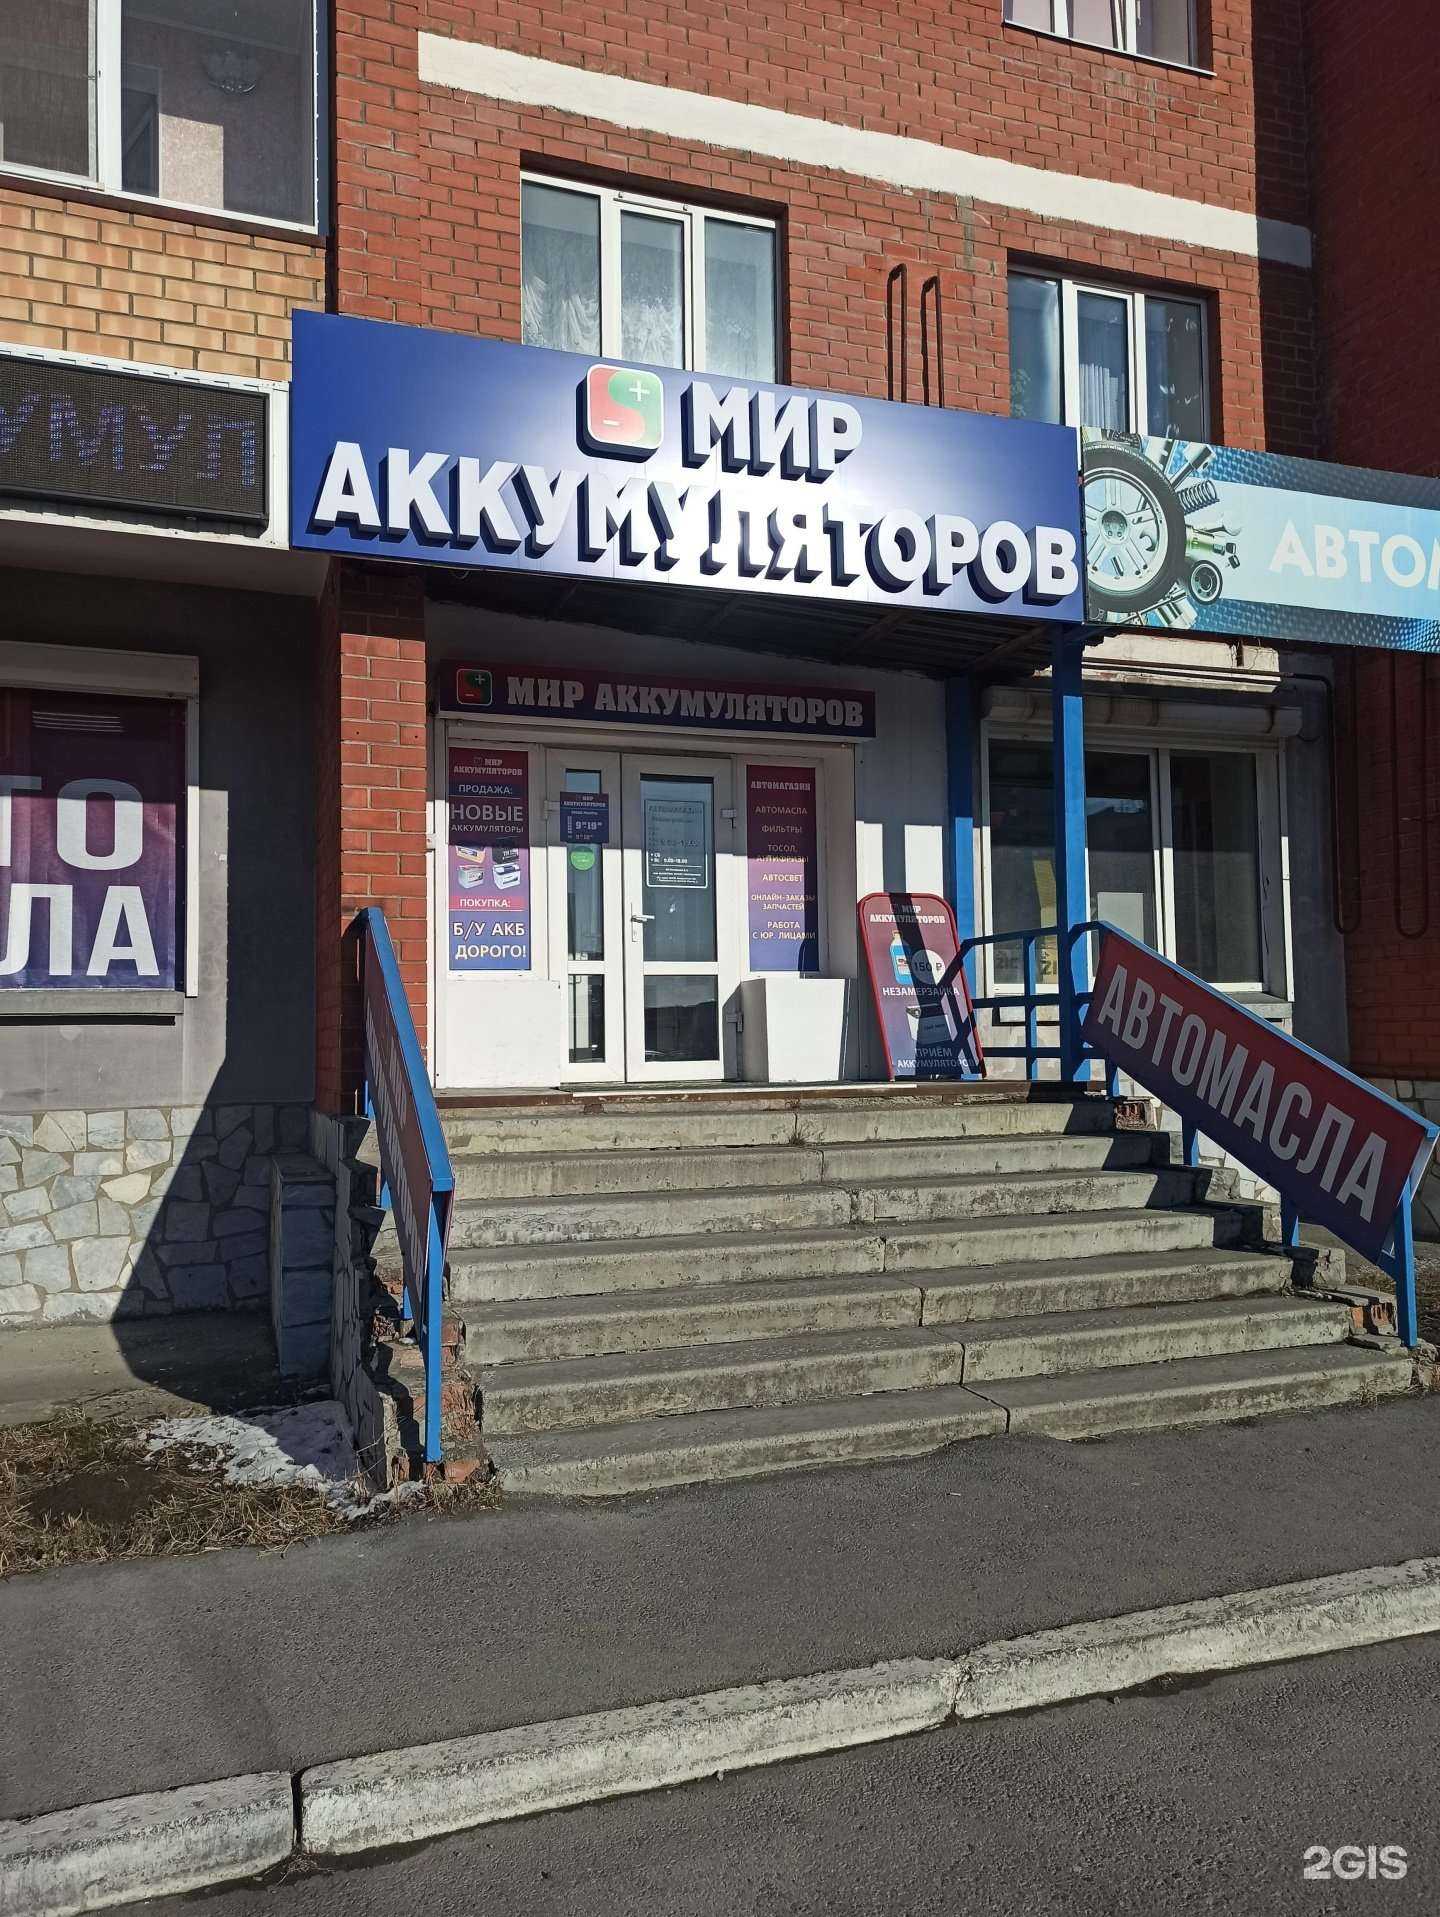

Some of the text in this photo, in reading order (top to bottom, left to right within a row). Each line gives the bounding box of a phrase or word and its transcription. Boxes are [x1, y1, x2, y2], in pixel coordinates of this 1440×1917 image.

[685, 381, 863, 477] МИР
[313, 441, 1078, 604] АККУМУЛЯТОРОВ
[1269, 519, 1440, 591] АВТО
[506, 676, 864, 727] МИР АККУМУЛЯТОРОВ
[750, 780, 811, 791] АВТОМАГАЗИН
[450, 803, 524, 822] НОВЫЕ
[755, 805, 808, 815] АВТОМАСЛА
[451, 824, 524, 833] АККУМУЛЯТОРЫ
[761, 824, 802, 833] ФИЛЬТРЫ
[762, 873, 803, 882] АВТОСВЕТ
[459, 898, 511, 908] ПОКУПКА:
[762, 902, 805, 911] ЗАПЧАСТЕЙ
[0, 883, 160, 976] ЛА
[767, 921, 801, 929] РАБОТА
[453, 921, 525, 941] Б/У АКБ
[778, 931, 816, 940] ЛИЦАМИ
[455, 944, 526, 960] ДОРОГО!
[882, 986, 960, 996] НЕЗАМЕРЗАЙКА
[1097, 964, 1388, 1223] АВТОМАСЛА
